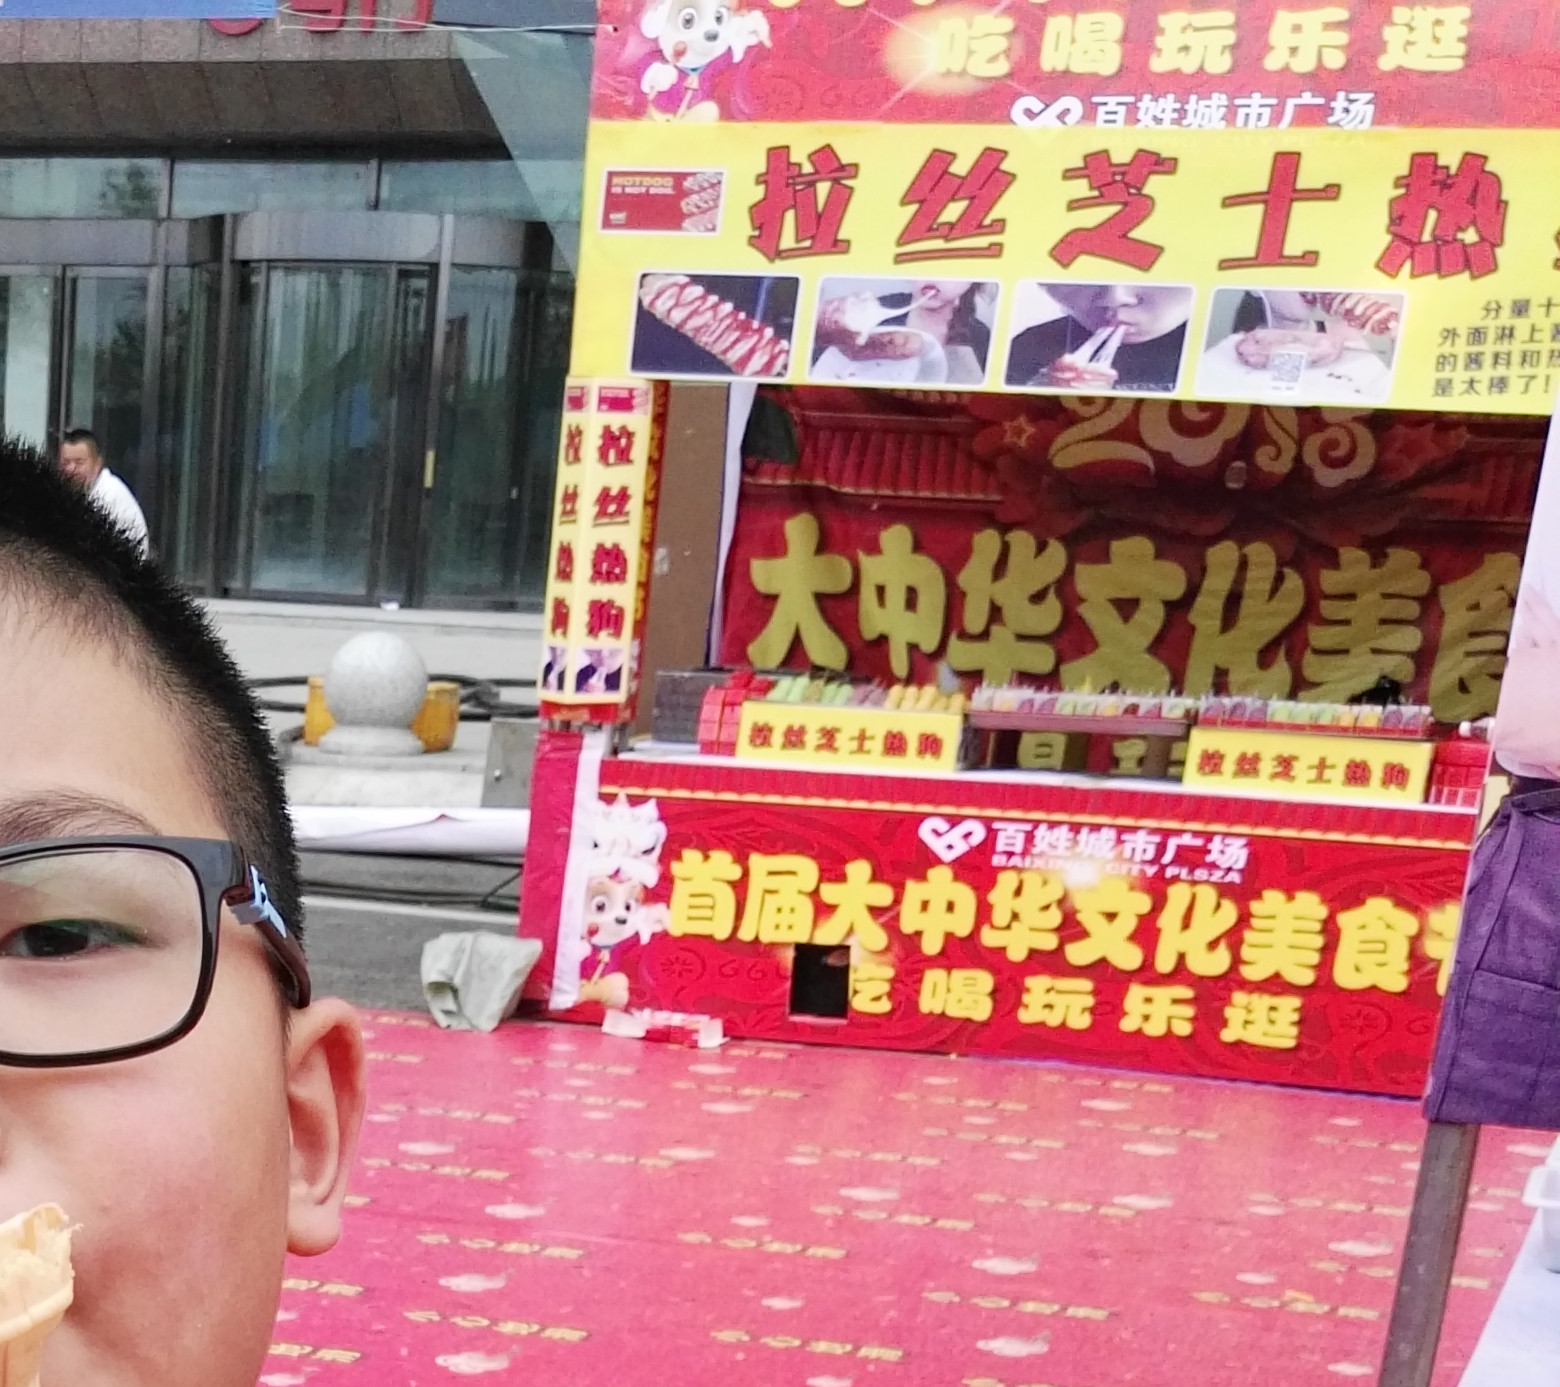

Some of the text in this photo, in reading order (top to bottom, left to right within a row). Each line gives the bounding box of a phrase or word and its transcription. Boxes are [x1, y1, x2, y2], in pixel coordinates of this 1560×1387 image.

[932, 4, 1471, 78] 吃喝玩乐逛
[1091, 91, 1376, 131] 百姓城市广场
[747, 145, 1560, 280] 拉丝芝士热
[586, 424, 635, 640] 拉丝热狗
[746, 512, 1522, 722] 大中华文化美食
[747, 719, 946, 762] 拉丝芝士热狗
[1196, 746, 1412, 791] 拉丝芝士热狗
[991, 820, 1250, 870] 百姓城市广场
